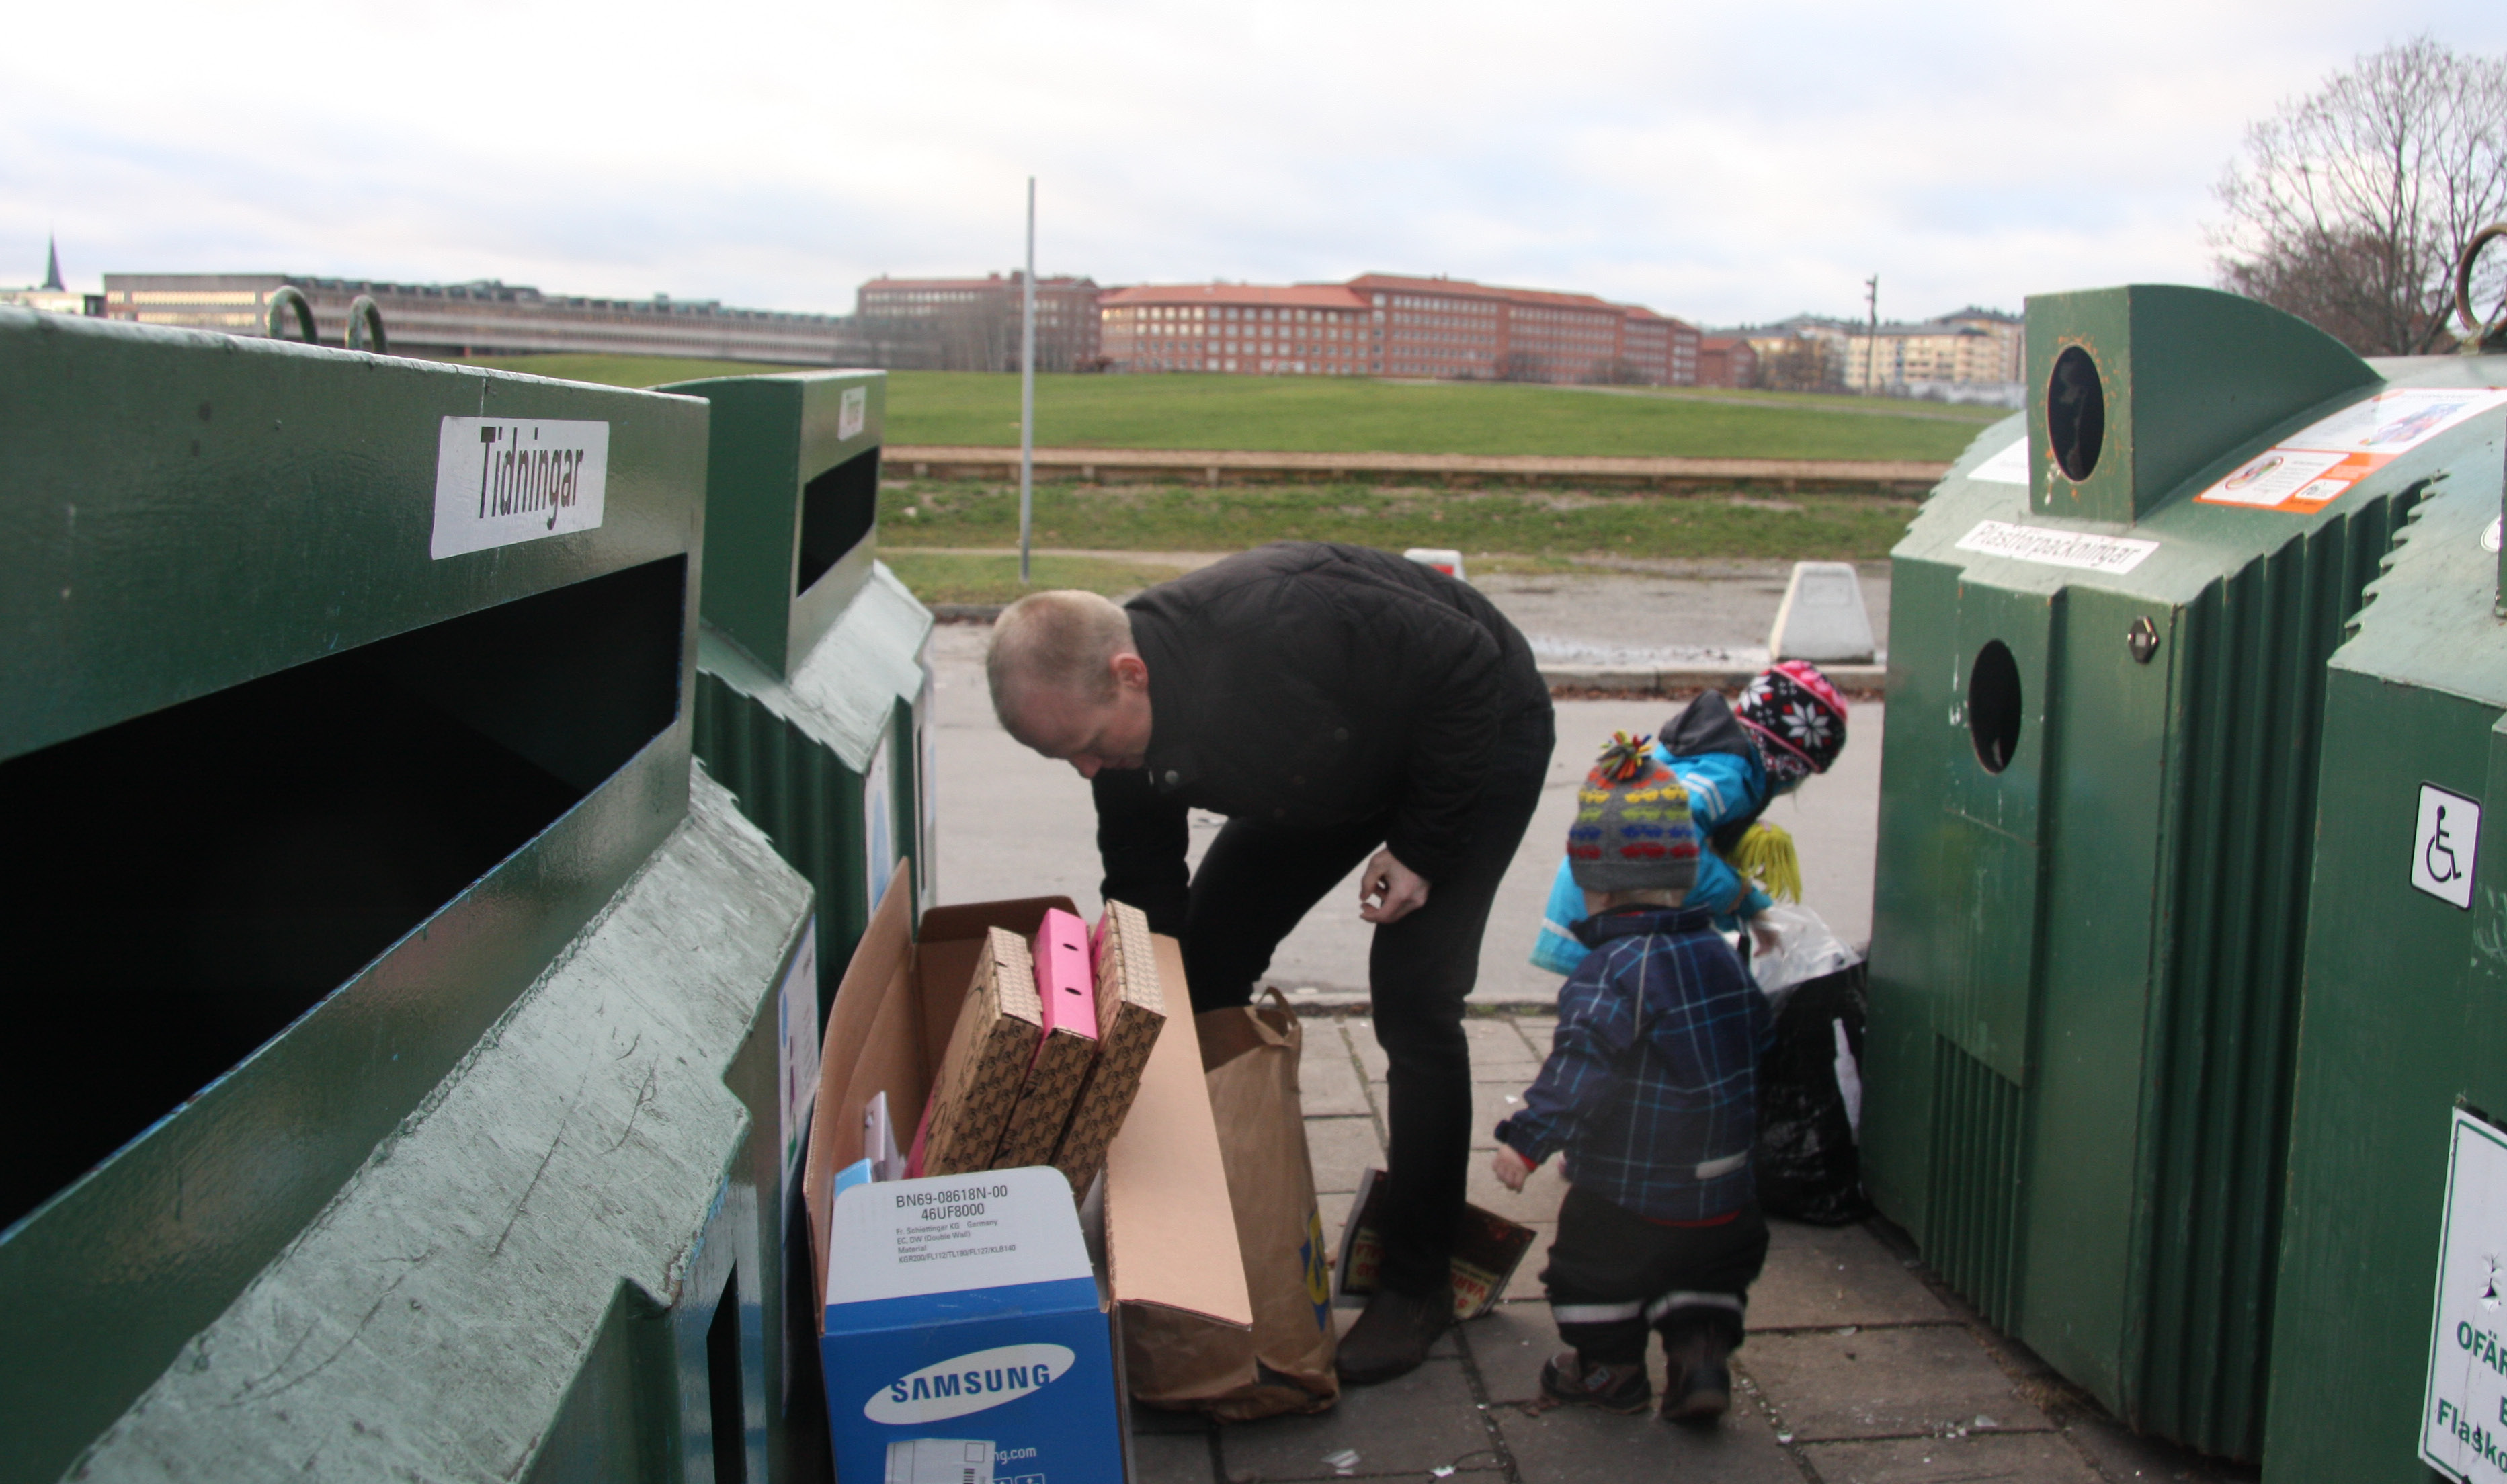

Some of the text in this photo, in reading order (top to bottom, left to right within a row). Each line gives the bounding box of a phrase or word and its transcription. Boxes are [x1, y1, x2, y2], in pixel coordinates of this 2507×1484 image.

[479, 426, 584, 531] Tidningar
[1969, 523, 2142, 567] Plastförpackningar
[896, 1184, 1008, 1208] BN69-08618N-00
[921, 1202, 985, 1221] 46UF8000
[949, 1222, 960, 1230] KG
[967, 1219, 998, 1229] Germany
[924, 1232, 950, 1242] (Double
[952, 1231, 971, 1239] Wall)
[897, 1245, 927, 1254] Material
[891, 1363, 1051, 1403] SAMSUNG
